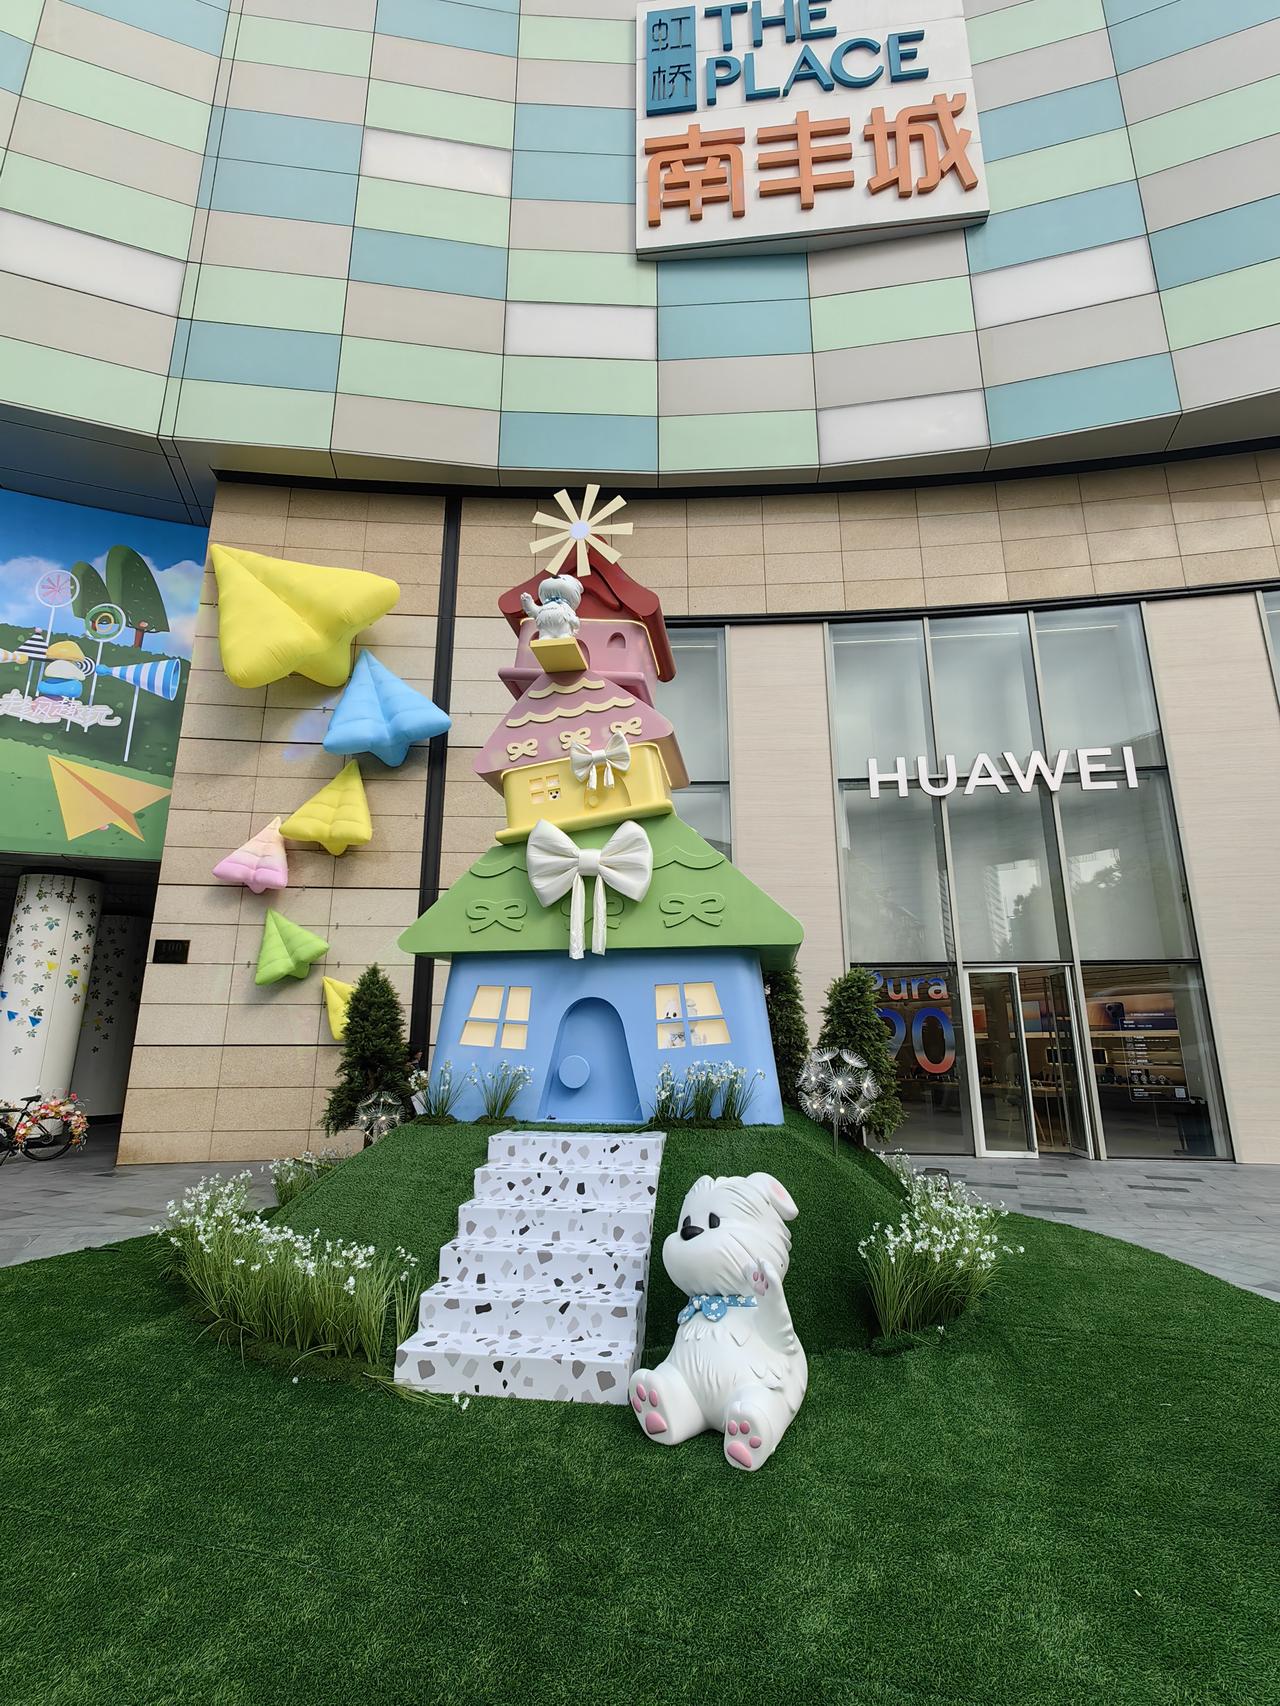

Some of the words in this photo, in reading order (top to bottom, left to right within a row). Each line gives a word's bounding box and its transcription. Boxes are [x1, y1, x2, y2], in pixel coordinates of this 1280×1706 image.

[651, 16, 692, 101] 虹桥
[703, 0, 837, 52] THE
[706, 29, 930, 106] PLACE
[644, 92, 979, 228] 南丰城
[867, 745, 1140, 799] HUAWEI
